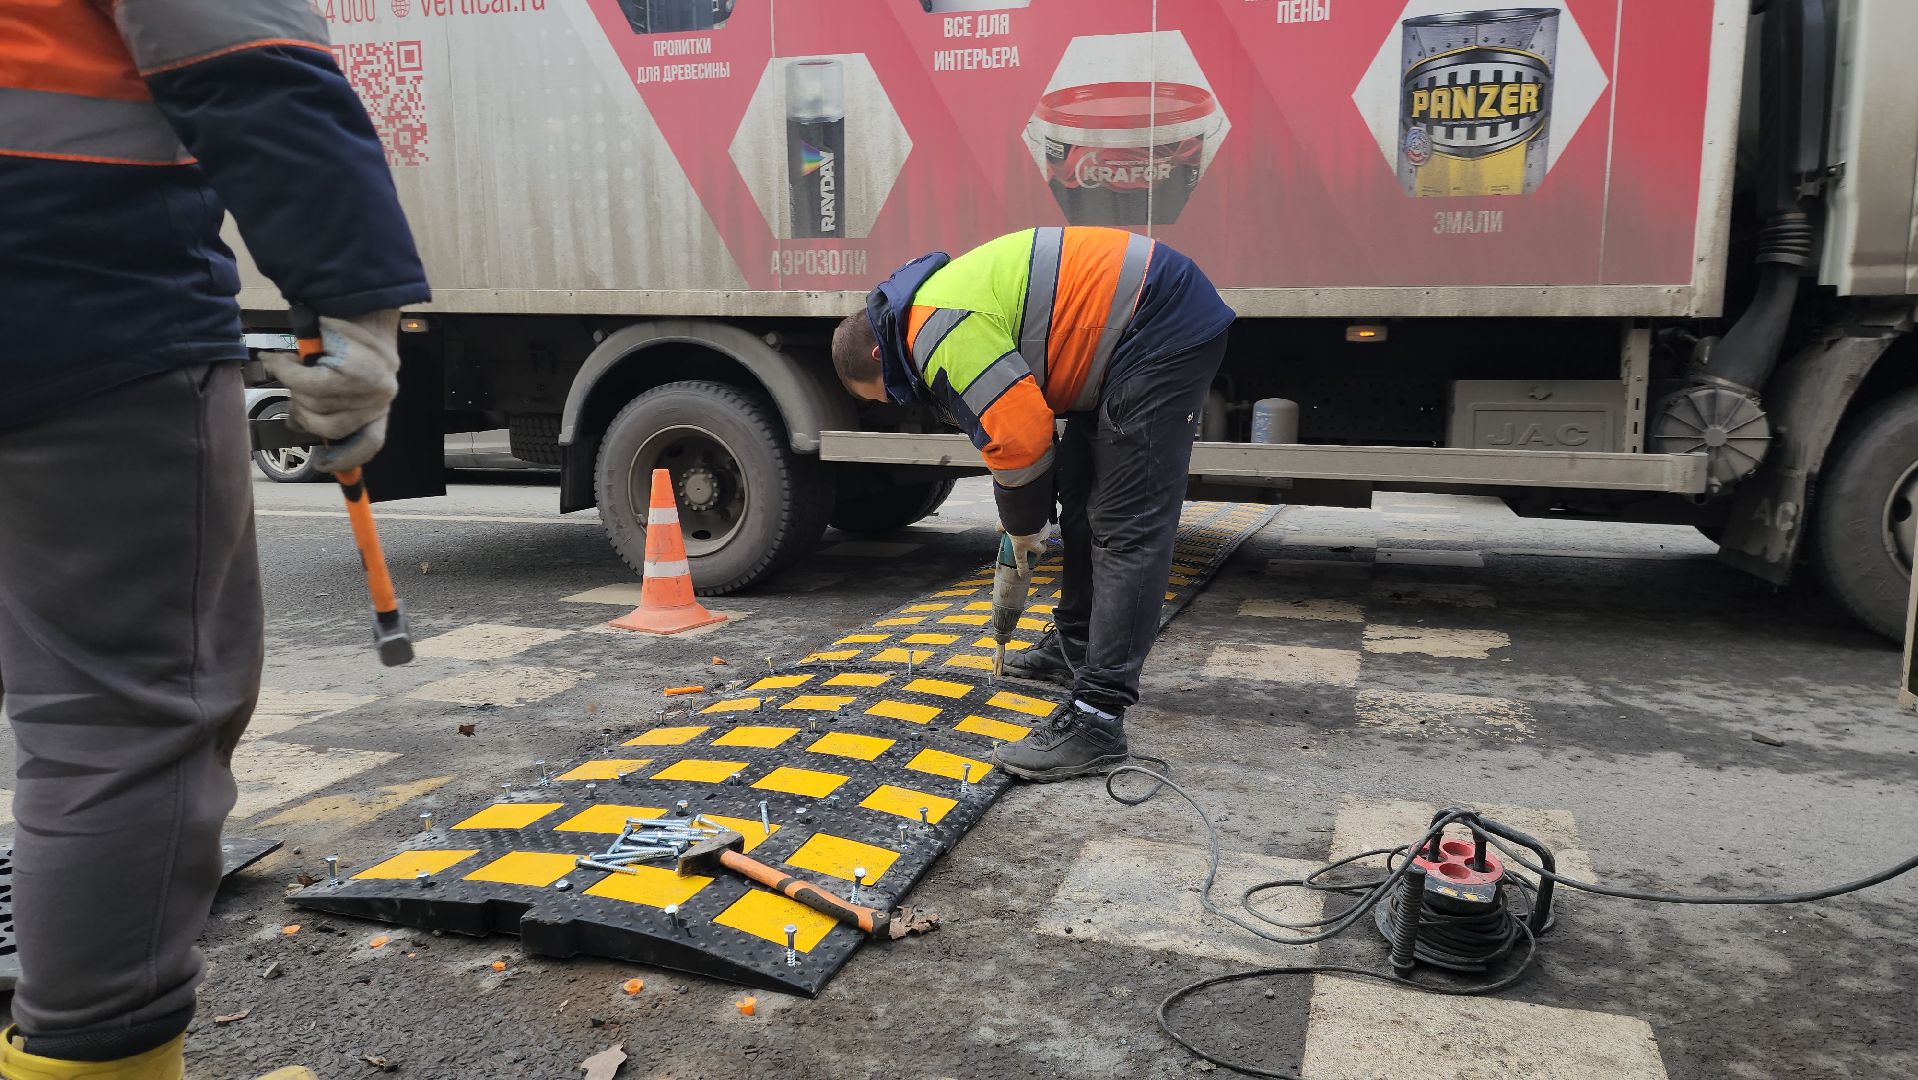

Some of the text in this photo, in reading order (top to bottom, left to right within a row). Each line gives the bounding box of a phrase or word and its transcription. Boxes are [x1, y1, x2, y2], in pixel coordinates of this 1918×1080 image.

[1277, 0, 1331, 24] ПЕНЫ
[943, 13, 1010, 38] ВСЕ ДЛЯ
[653, 38, 711, 57] ПРОПИТКИ
[934, 45, 1020, 72] ИНТЕРЬЕРА
[637, 62, 730, 84] ДЛЯ ДРЕВЕСИНЫ
[1411, 83, 1539, 119] PANZER
[1083, 163, 1172, 183] KRAFOR
[819, 151, 836, 232] RAYDAY
[1433, 210, 1504, 234] ЭМАЛИ
[770, 249, 867, 275] АЭРОЗОЛИ
[1487, 422, 1590, 447] JAC
